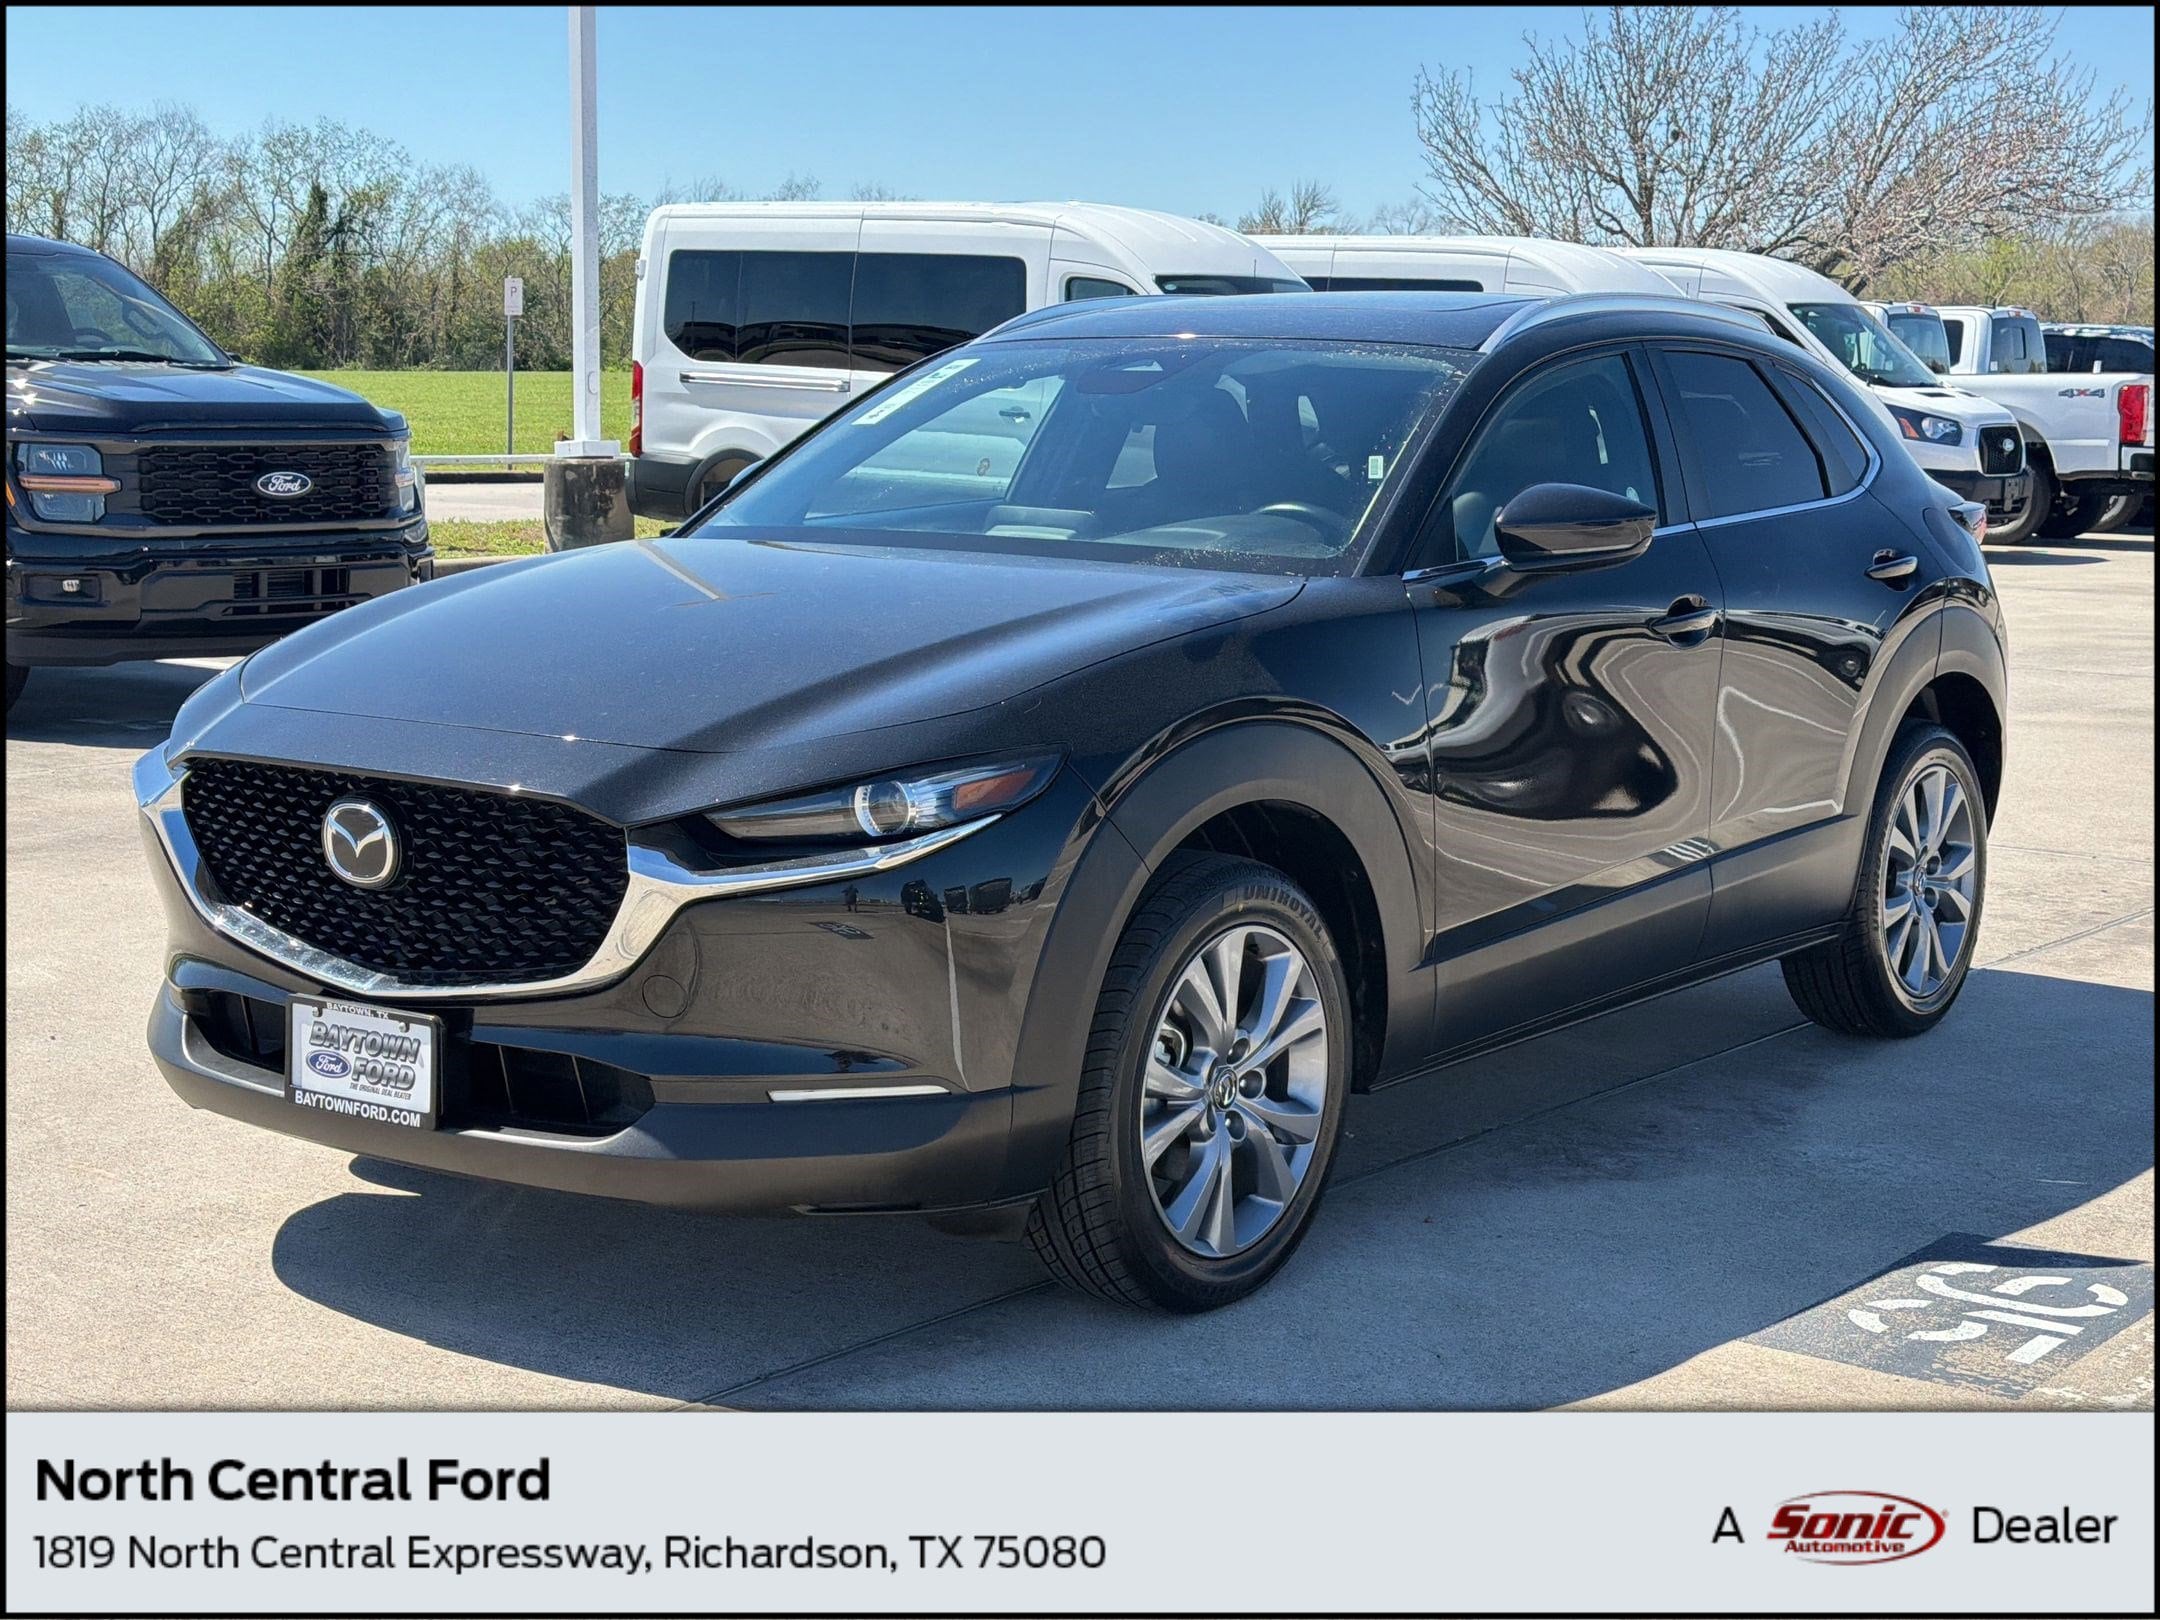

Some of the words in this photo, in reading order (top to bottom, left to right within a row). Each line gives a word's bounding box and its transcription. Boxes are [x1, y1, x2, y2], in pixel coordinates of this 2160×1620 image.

[268, 475, 301, 492] Ford
[1246, 884, 1322, 941] UNIROYAL
[377, 1011, 390, 1020] TX
[309, 1021, 421, 1064] BAYTOWN
[315, 1054, 344, 1074] Ford
[351, 1056, 416, 1091] FORD
[294, 1089, 421, 1128] BAYTOWNFORD.COM
